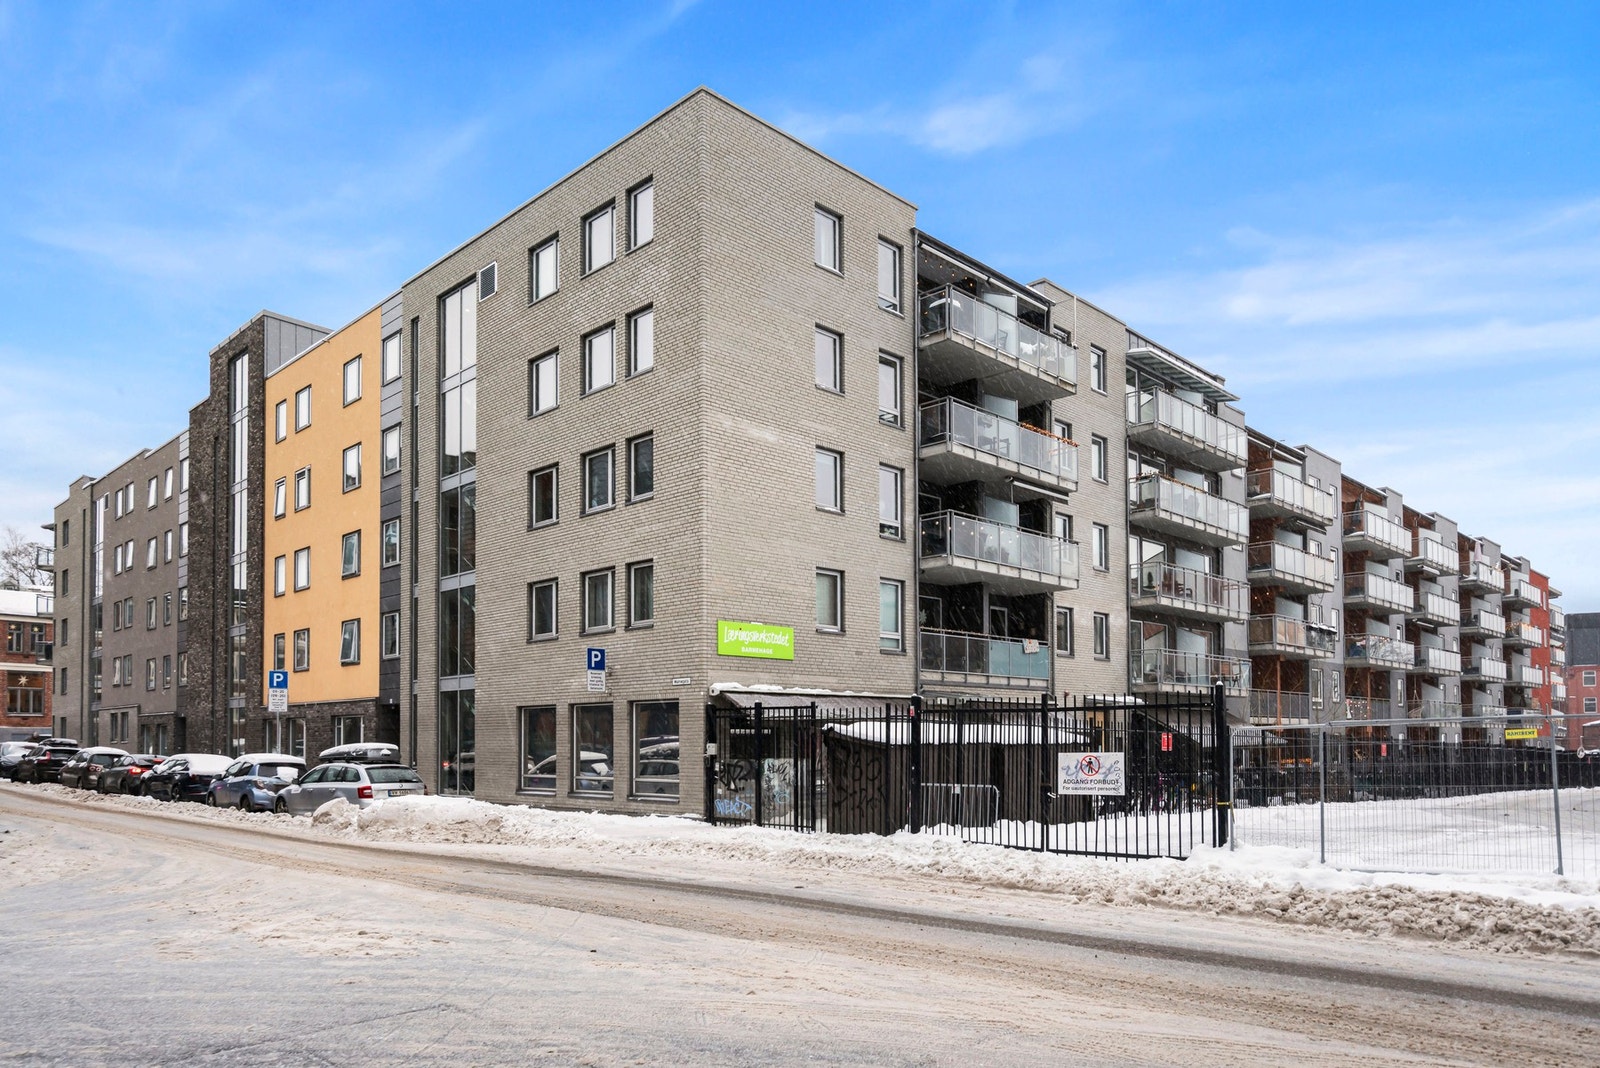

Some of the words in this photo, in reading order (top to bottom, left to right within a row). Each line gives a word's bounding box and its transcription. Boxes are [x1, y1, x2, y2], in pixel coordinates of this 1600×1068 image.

[741, 646, 773, 655] BARNEHAGE
[591, 650, 602, 668] P
[273, 673, 284, 686] P
